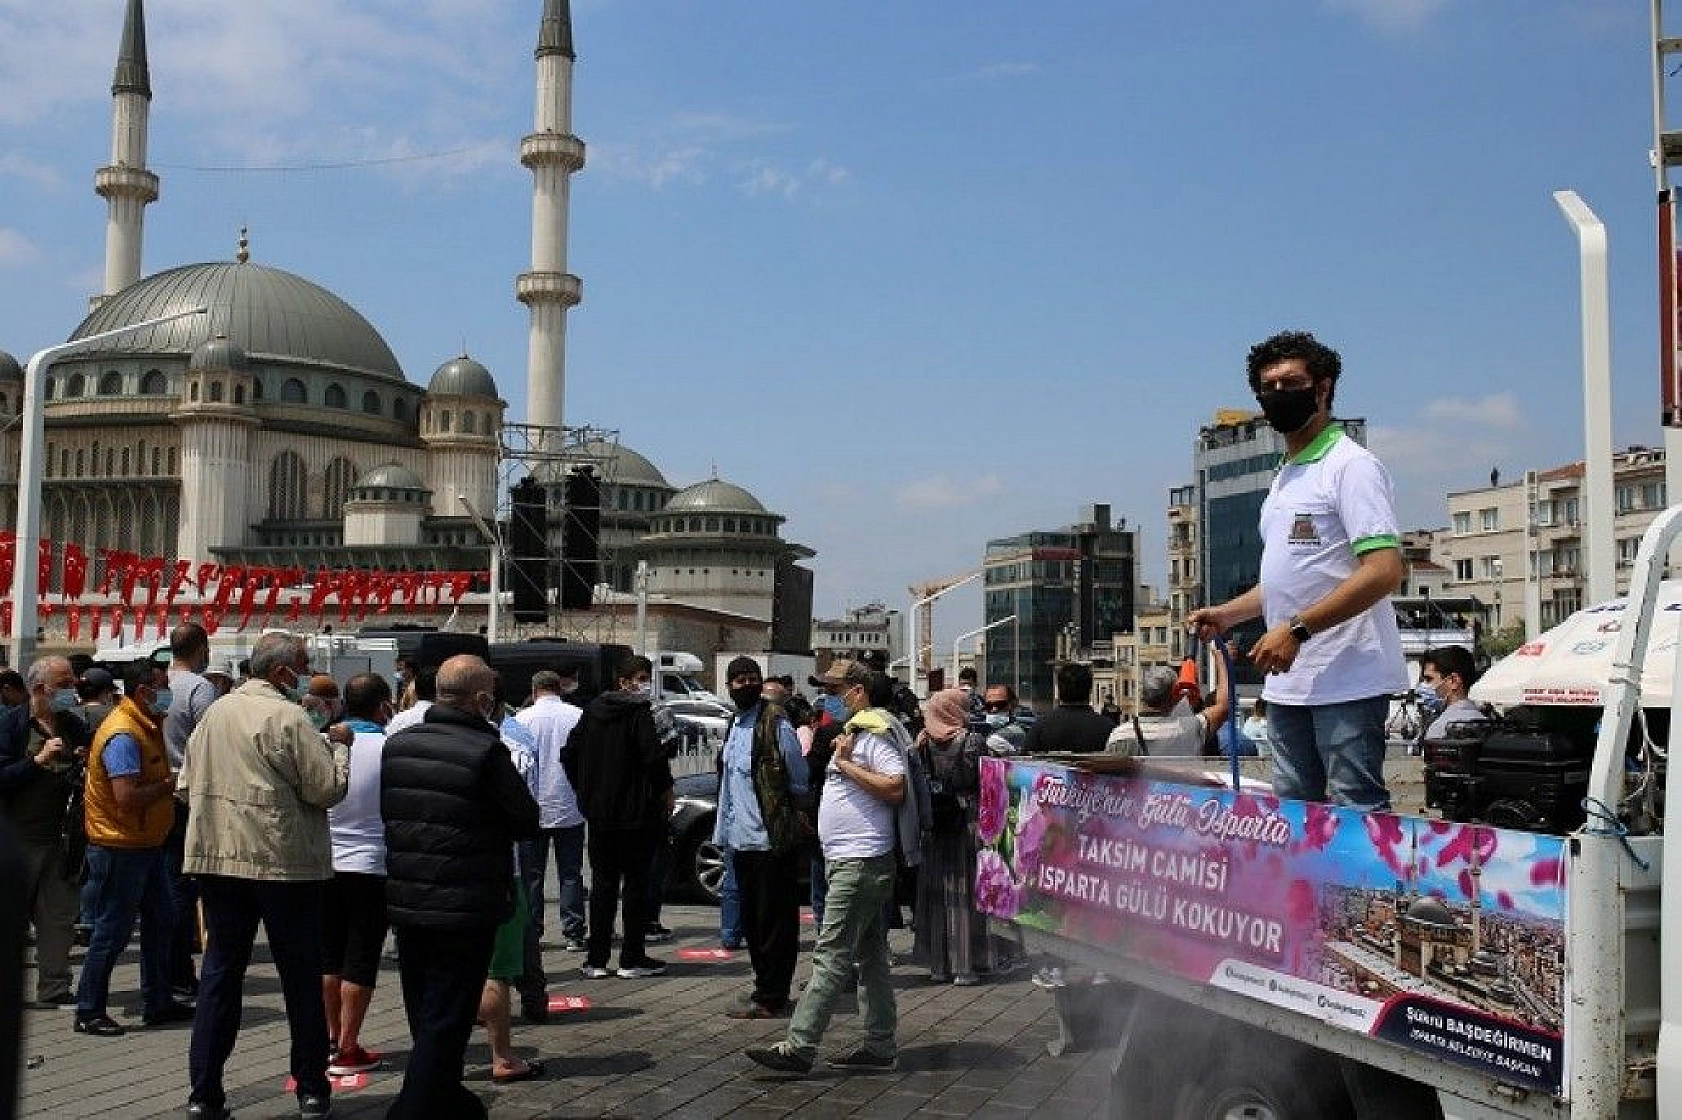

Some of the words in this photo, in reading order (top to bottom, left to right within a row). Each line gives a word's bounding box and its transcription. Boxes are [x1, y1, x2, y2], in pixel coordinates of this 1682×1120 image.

[1078, 833, 1149, 873] TAKSİM
[1152, 850, 1229, 893] CAMİSİ
[1038, 863, 1109, 905] ISPARTA
[1116, 879, 1168, 920] GÜLÜ
[1171, 897, 1283, 953] KOKUYOR
[1446, 1017, 1552, 1063] BAŞDEĞİRMEN
